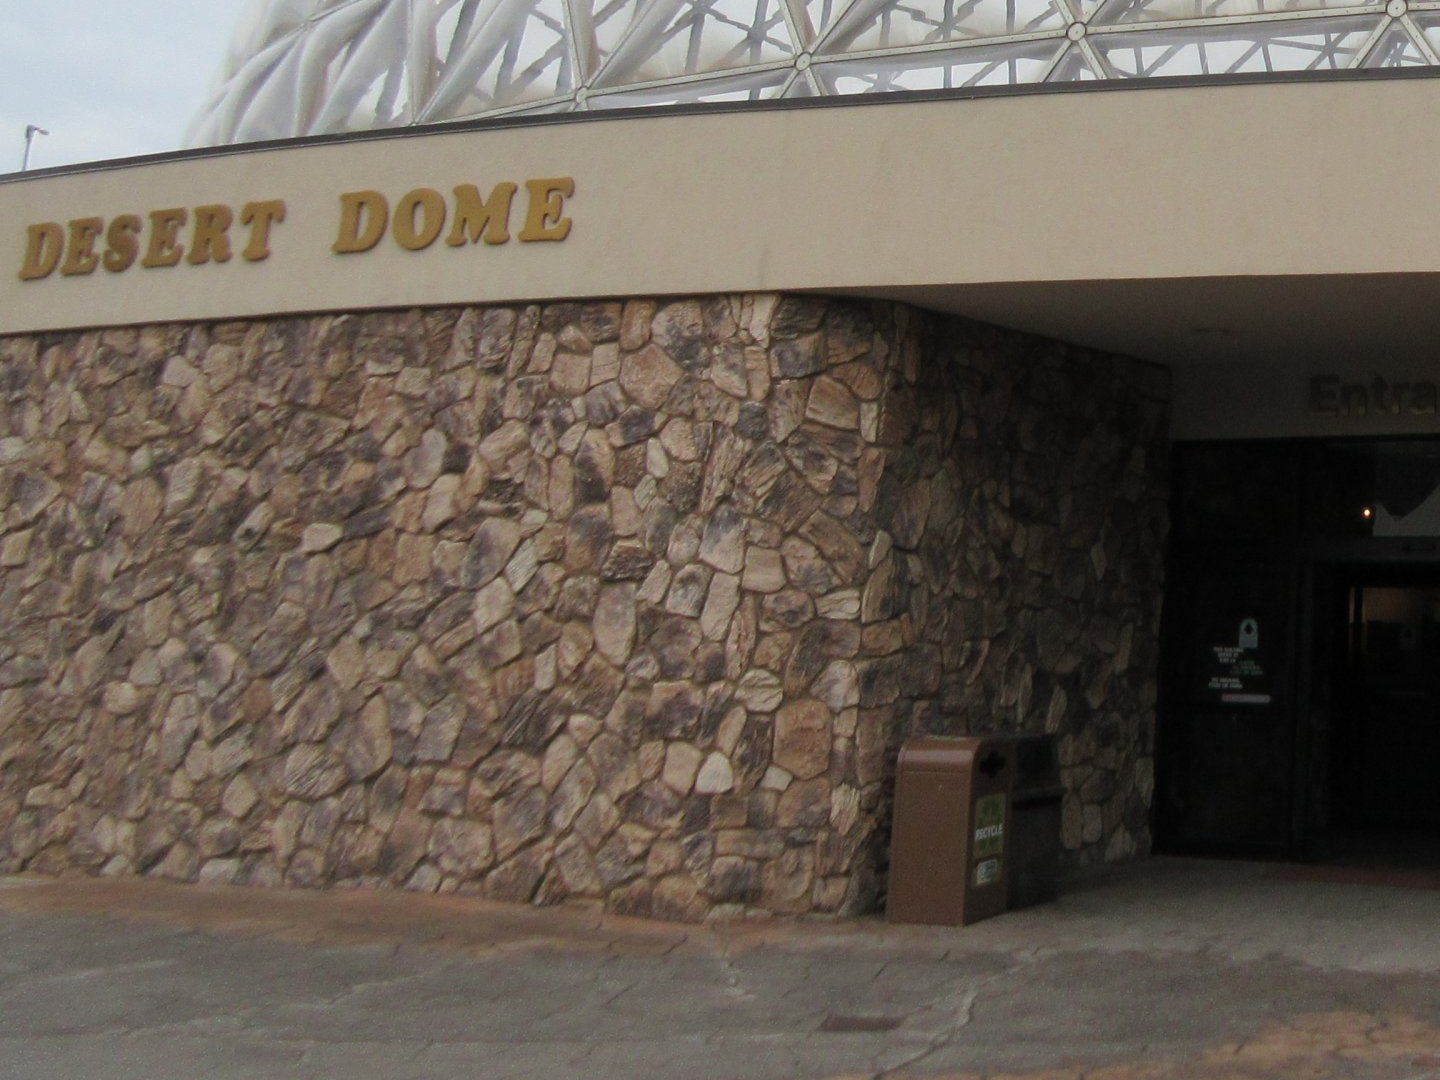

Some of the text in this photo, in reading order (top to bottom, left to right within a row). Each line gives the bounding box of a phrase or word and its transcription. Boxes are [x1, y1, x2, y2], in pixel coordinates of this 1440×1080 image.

[18, 176, 577, 281] DESERT DOME
[975, 823, 1003, 840] RECYCLE
